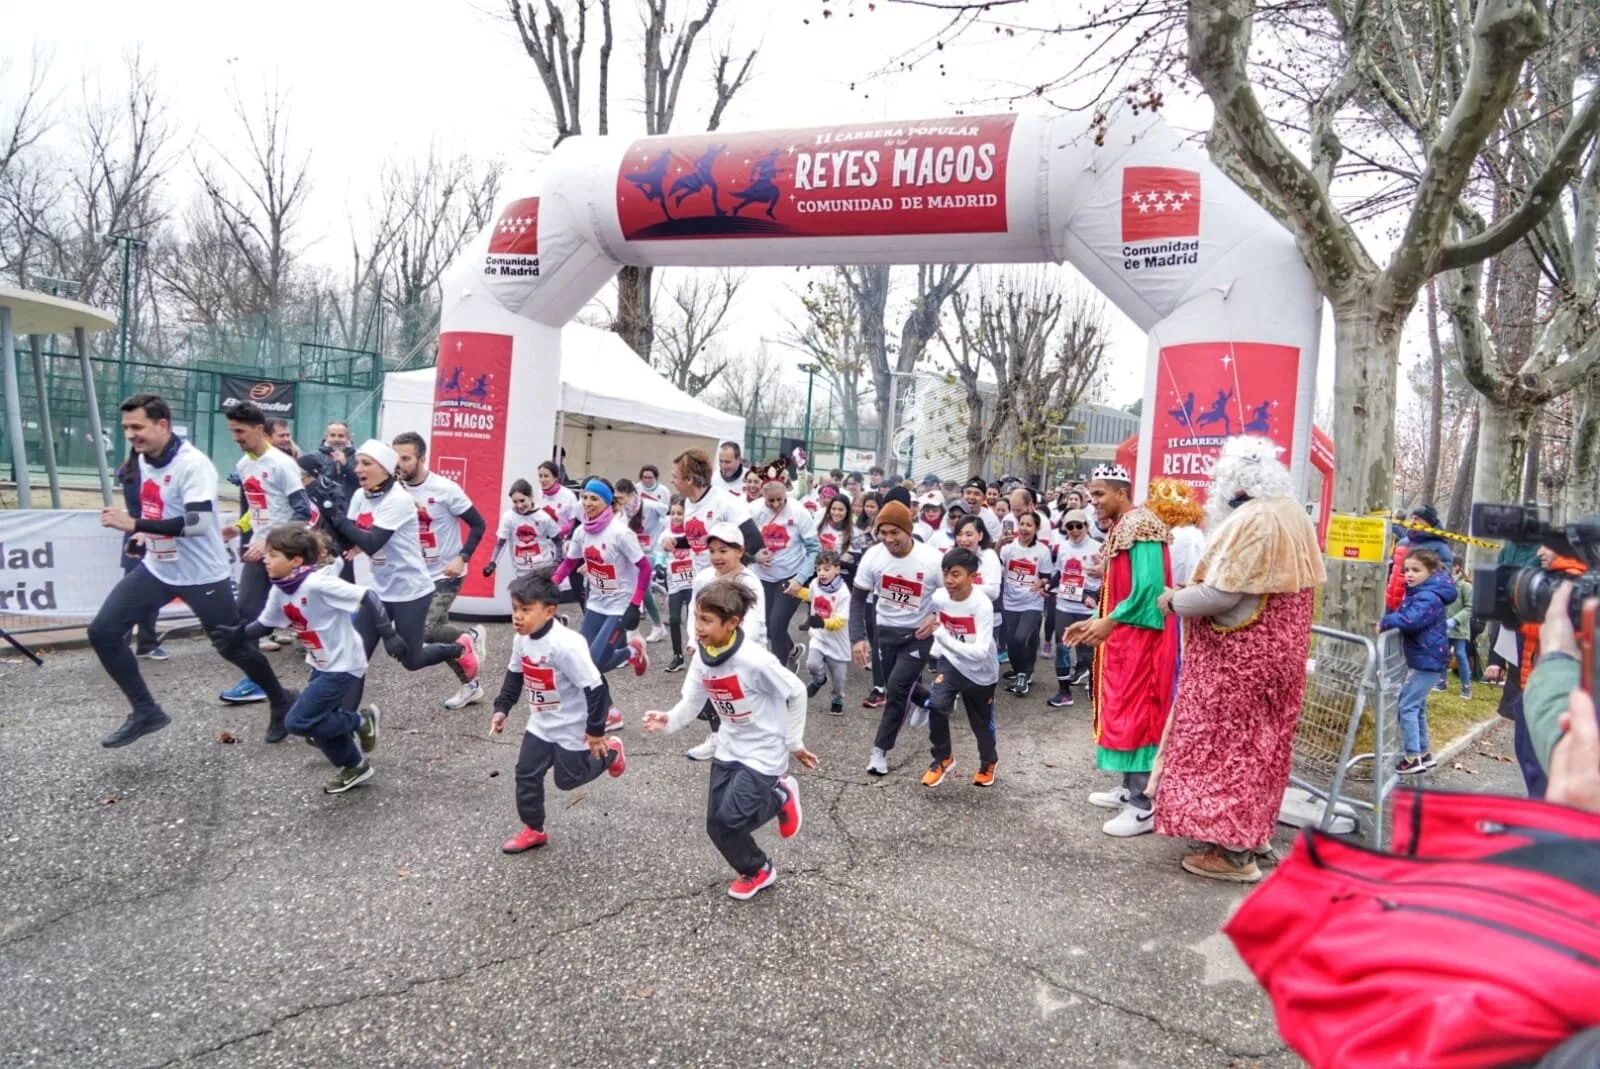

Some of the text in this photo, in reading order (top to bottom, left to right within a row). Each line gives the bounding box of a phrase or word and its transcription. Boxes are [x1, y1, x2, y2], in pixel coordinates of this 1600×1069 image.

[835, 127, 904, 143] CARRERA
[908, 126, 979, 138] POPULAR
[795, 143, 996, 190] REYES MAGOS
[797, 194, 998, 213] COMUNIDAD DE MADRID
[1122, 240, 1199, 257] Comunidad
[485, 256, 540, 266] Comunidad
[1124, 252, 1198, 270] de Madrid
[484, 266, 540, 276] de Madrid
[454, 412, 495, 430] MAGOS
[463, 432, 492, 440] MADRID
[1163, 452, 1215, 476] REYES
[892, 592, 910, 603] 172
